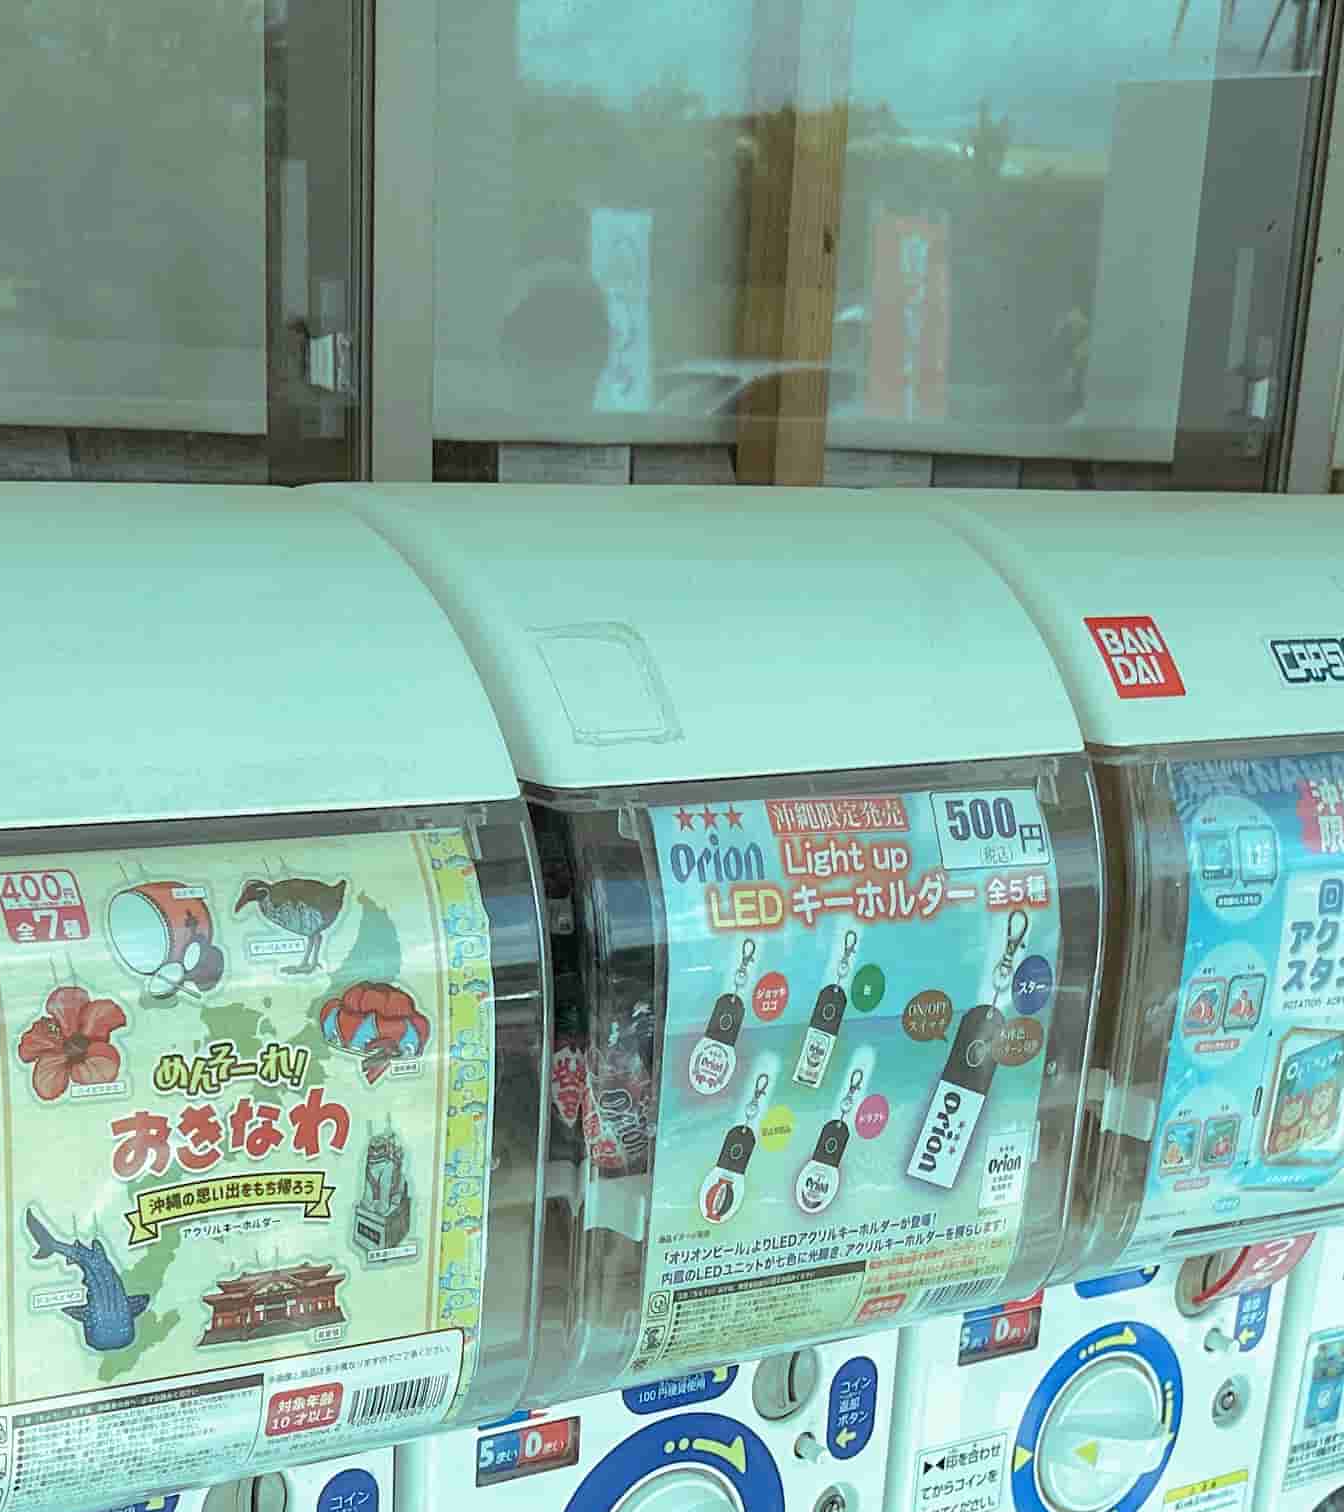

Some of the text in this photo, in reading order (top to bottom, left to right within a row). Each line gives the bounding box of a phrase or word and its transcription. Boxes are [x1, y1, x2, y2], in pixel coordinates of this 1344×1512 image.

[1096, 627, 1166, 655] BAN
[1114, 655, 1166, 686] DAI
[945, 796, 1046, 855] 500円
[670, 833, 765, 883] Orion
[784, 843, 910, 876] Light up
[709, 889, 784, 929] LED
[792, 876, 976, 924] キーホルダー
[112, 1089, 350, 1178] おきなわ
[917, 1090, 962, 1174] Orion
[988, 1154, 1022, 1174] Orion
[149, 1179, 315, 1215] 沖縄の思い出をもち帰ろう
[183, 1216, 281, 1240] アクリルキーホルダー
[839, 1375, 871, 1395] コイン
[331, 1489, 370, 1510] コイン
